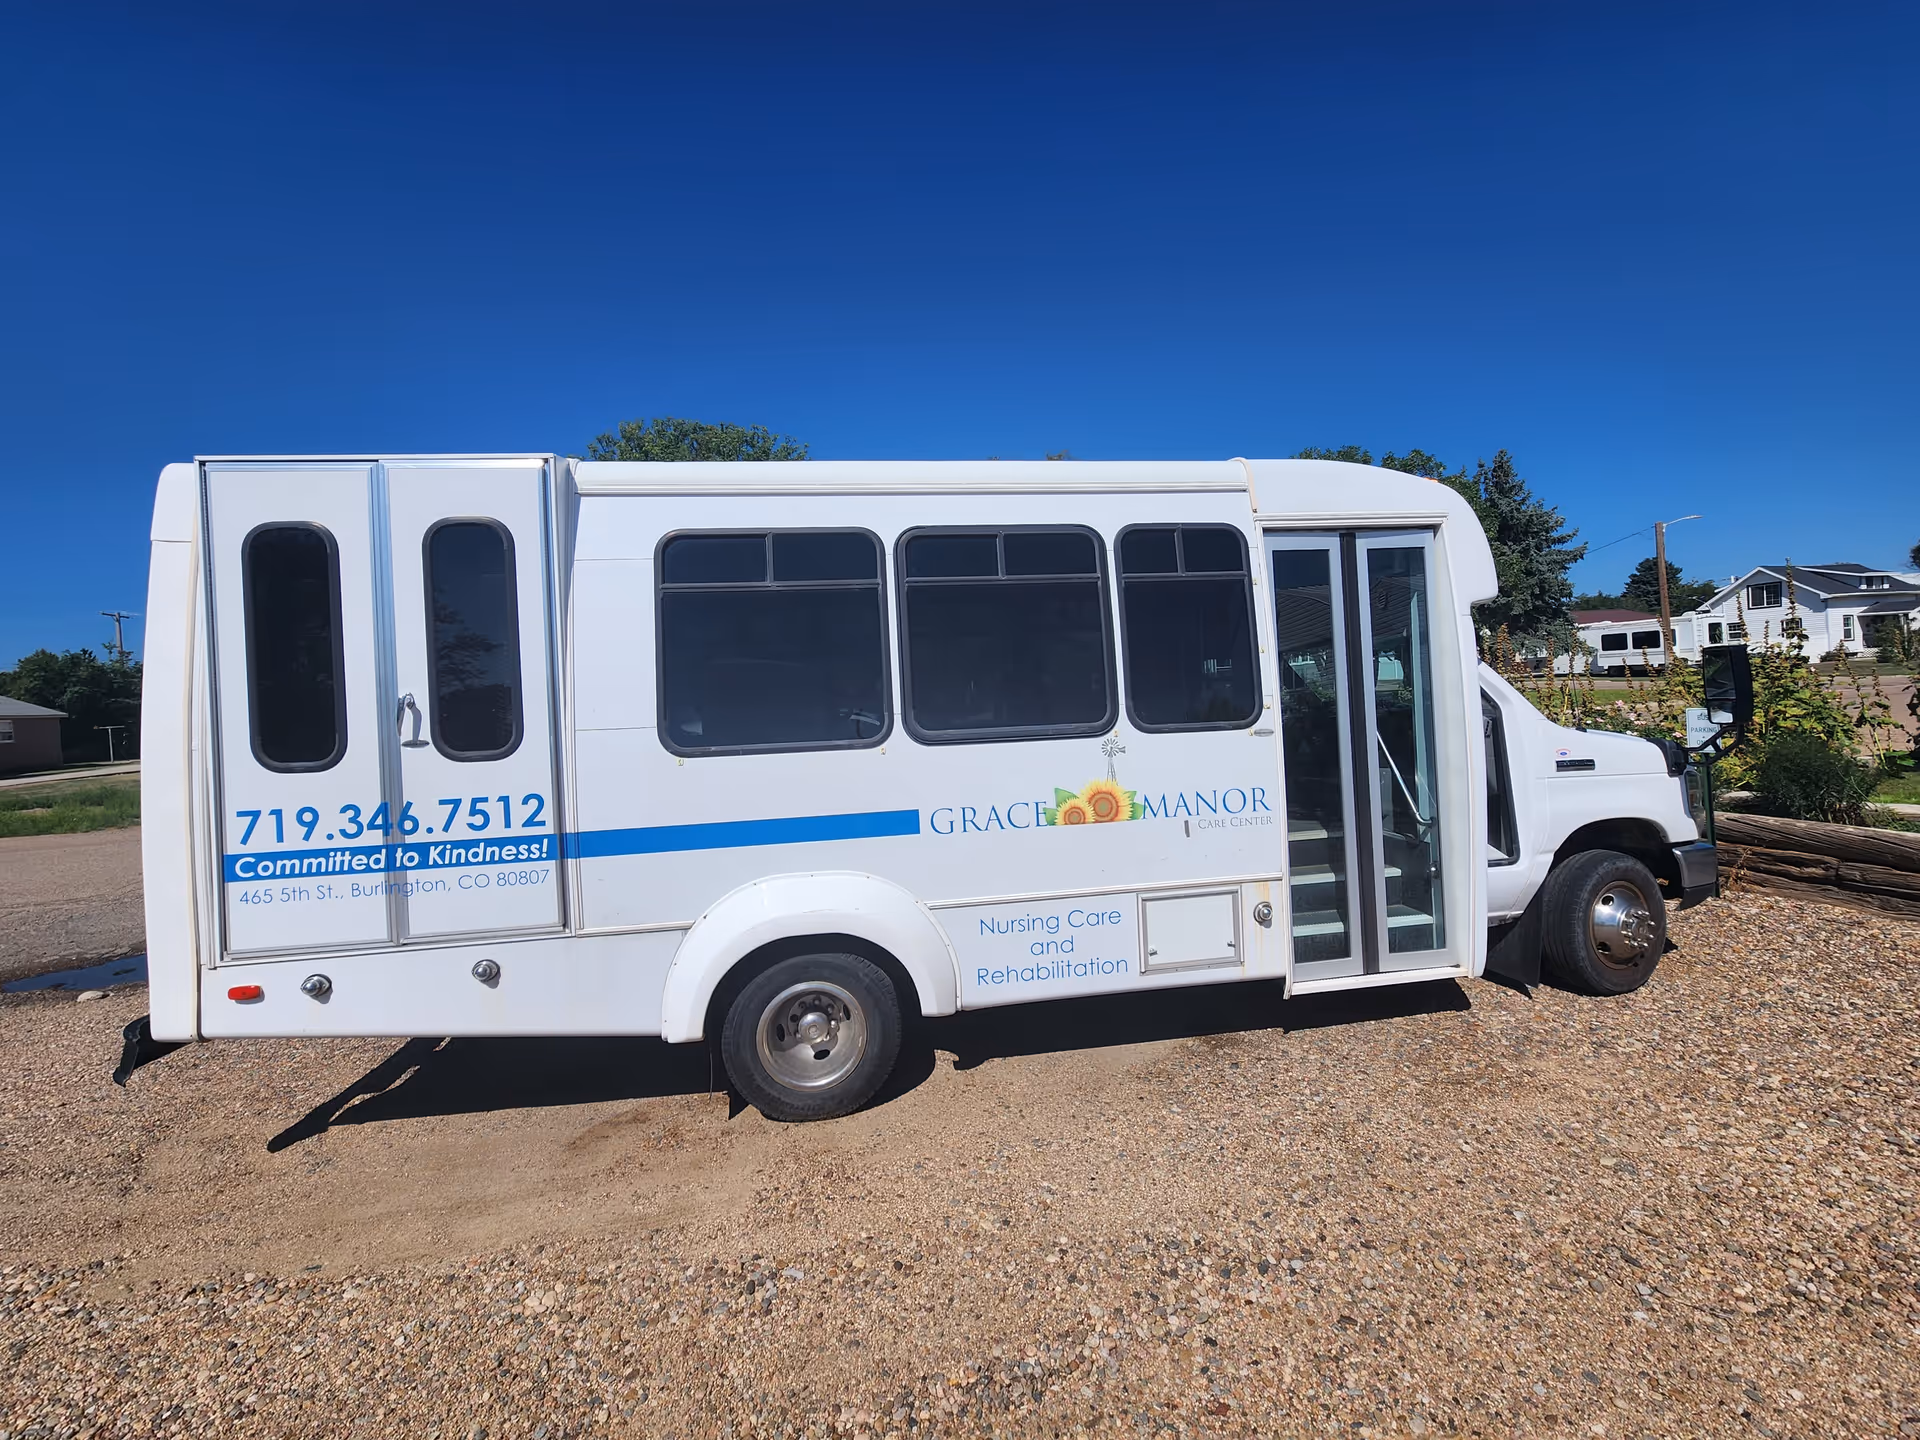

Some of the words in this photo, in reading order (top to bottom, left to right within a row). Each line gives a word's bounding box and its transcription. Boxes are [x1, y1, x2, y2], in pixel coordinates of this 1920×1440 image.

[235, 793, 547, 846] 719.346.7512
[930, 801, 1050, 835] GRACE
[1142, 787, 1272, 820] MANOR
[1197, 818, 1227, 830] CARE
[1229, 815, 1273, 828] CENTER
[234, 848, 387, 878] Committed
[395, 847, 420, 868] to
[428, 838, 549, 866] Kindness!
[239, 888, 273, 905] 465
[280, 885, 310, 903] 5th
[316, 884, 344, 900] St.,
[351, 878, 452, 898] Burlington,
[458, 873, 490, 889] CO
[496, 869, 550, 887] 80807
[979, 913, 1060, 936] Nursing
[1067, 908, 1122, 929] Care
[1029, 936, 1075, 956] and
[976, 956, 1129, 986] Rehabilitation
